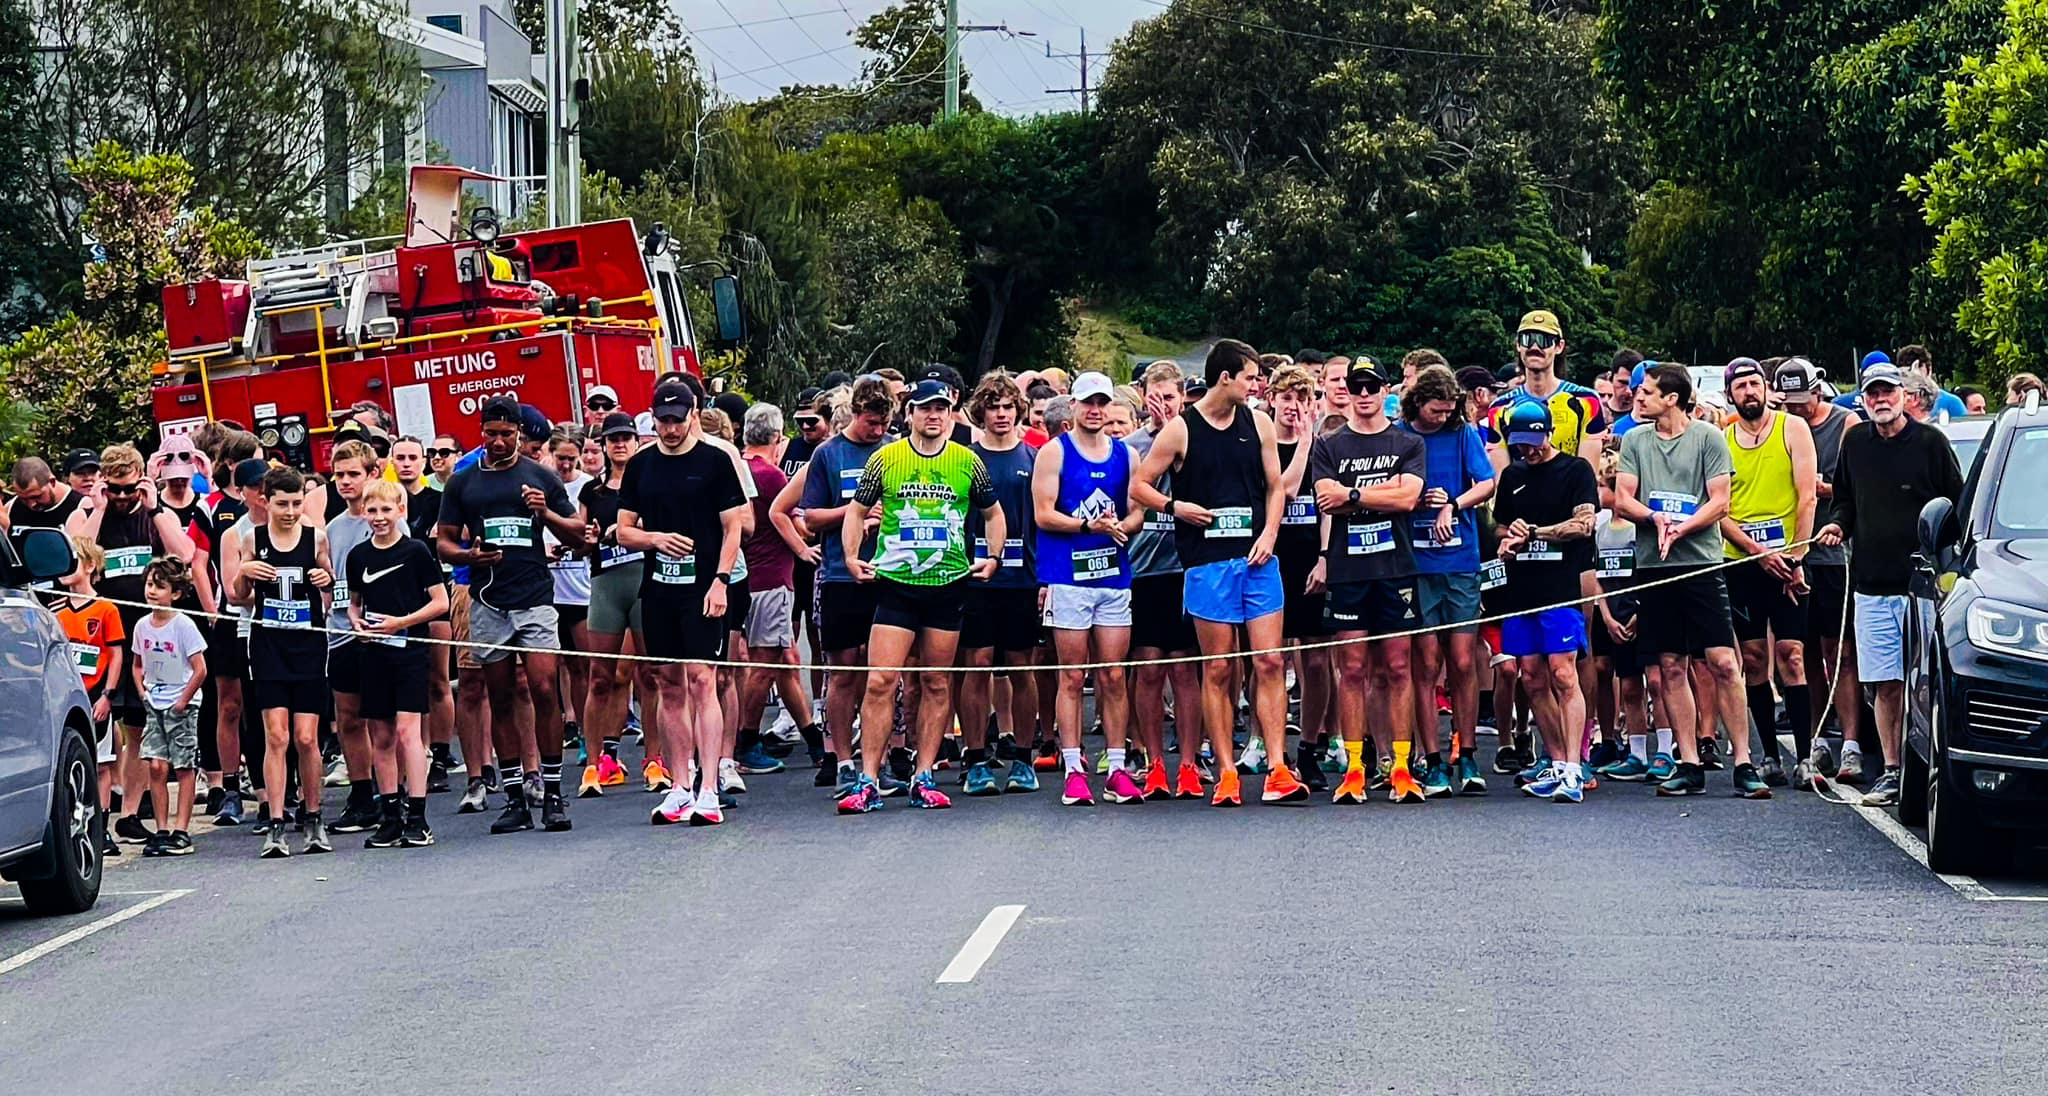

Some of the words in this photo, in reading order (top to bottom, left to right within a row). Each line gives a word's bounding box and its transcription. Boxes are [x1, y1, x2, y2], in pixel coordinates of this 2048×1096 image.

[413, 350, 497, 380] METUNG
[448, 374, 525, 395] EMERGENCY
[1350, 457, 1373, 472] YOU
[901, 484, 953, 493] HALLORA
[896, 491, 958, 501] MARATHON
[1288, 504, 1306, 516] 100
[1661, 500, 1682, 512] 135
[1219, 516, 1242, 529] 095
[498, 525, 519, 537] 163
[912, 527, 934, 540] 169
[1750, 529, 1768, 541] 174
[1360, 532, 1378, 546] 101
[118, 555, 138, 567] 173
[1087, 556, 1109, 571] 068
[1604, 557, 1620, 569] 135
[662, 563, 680, 576] 128
[1488, 565, 1507, 580] 067
[271, 566, 304, 601] T
[277, 609, 297, 621] 125
